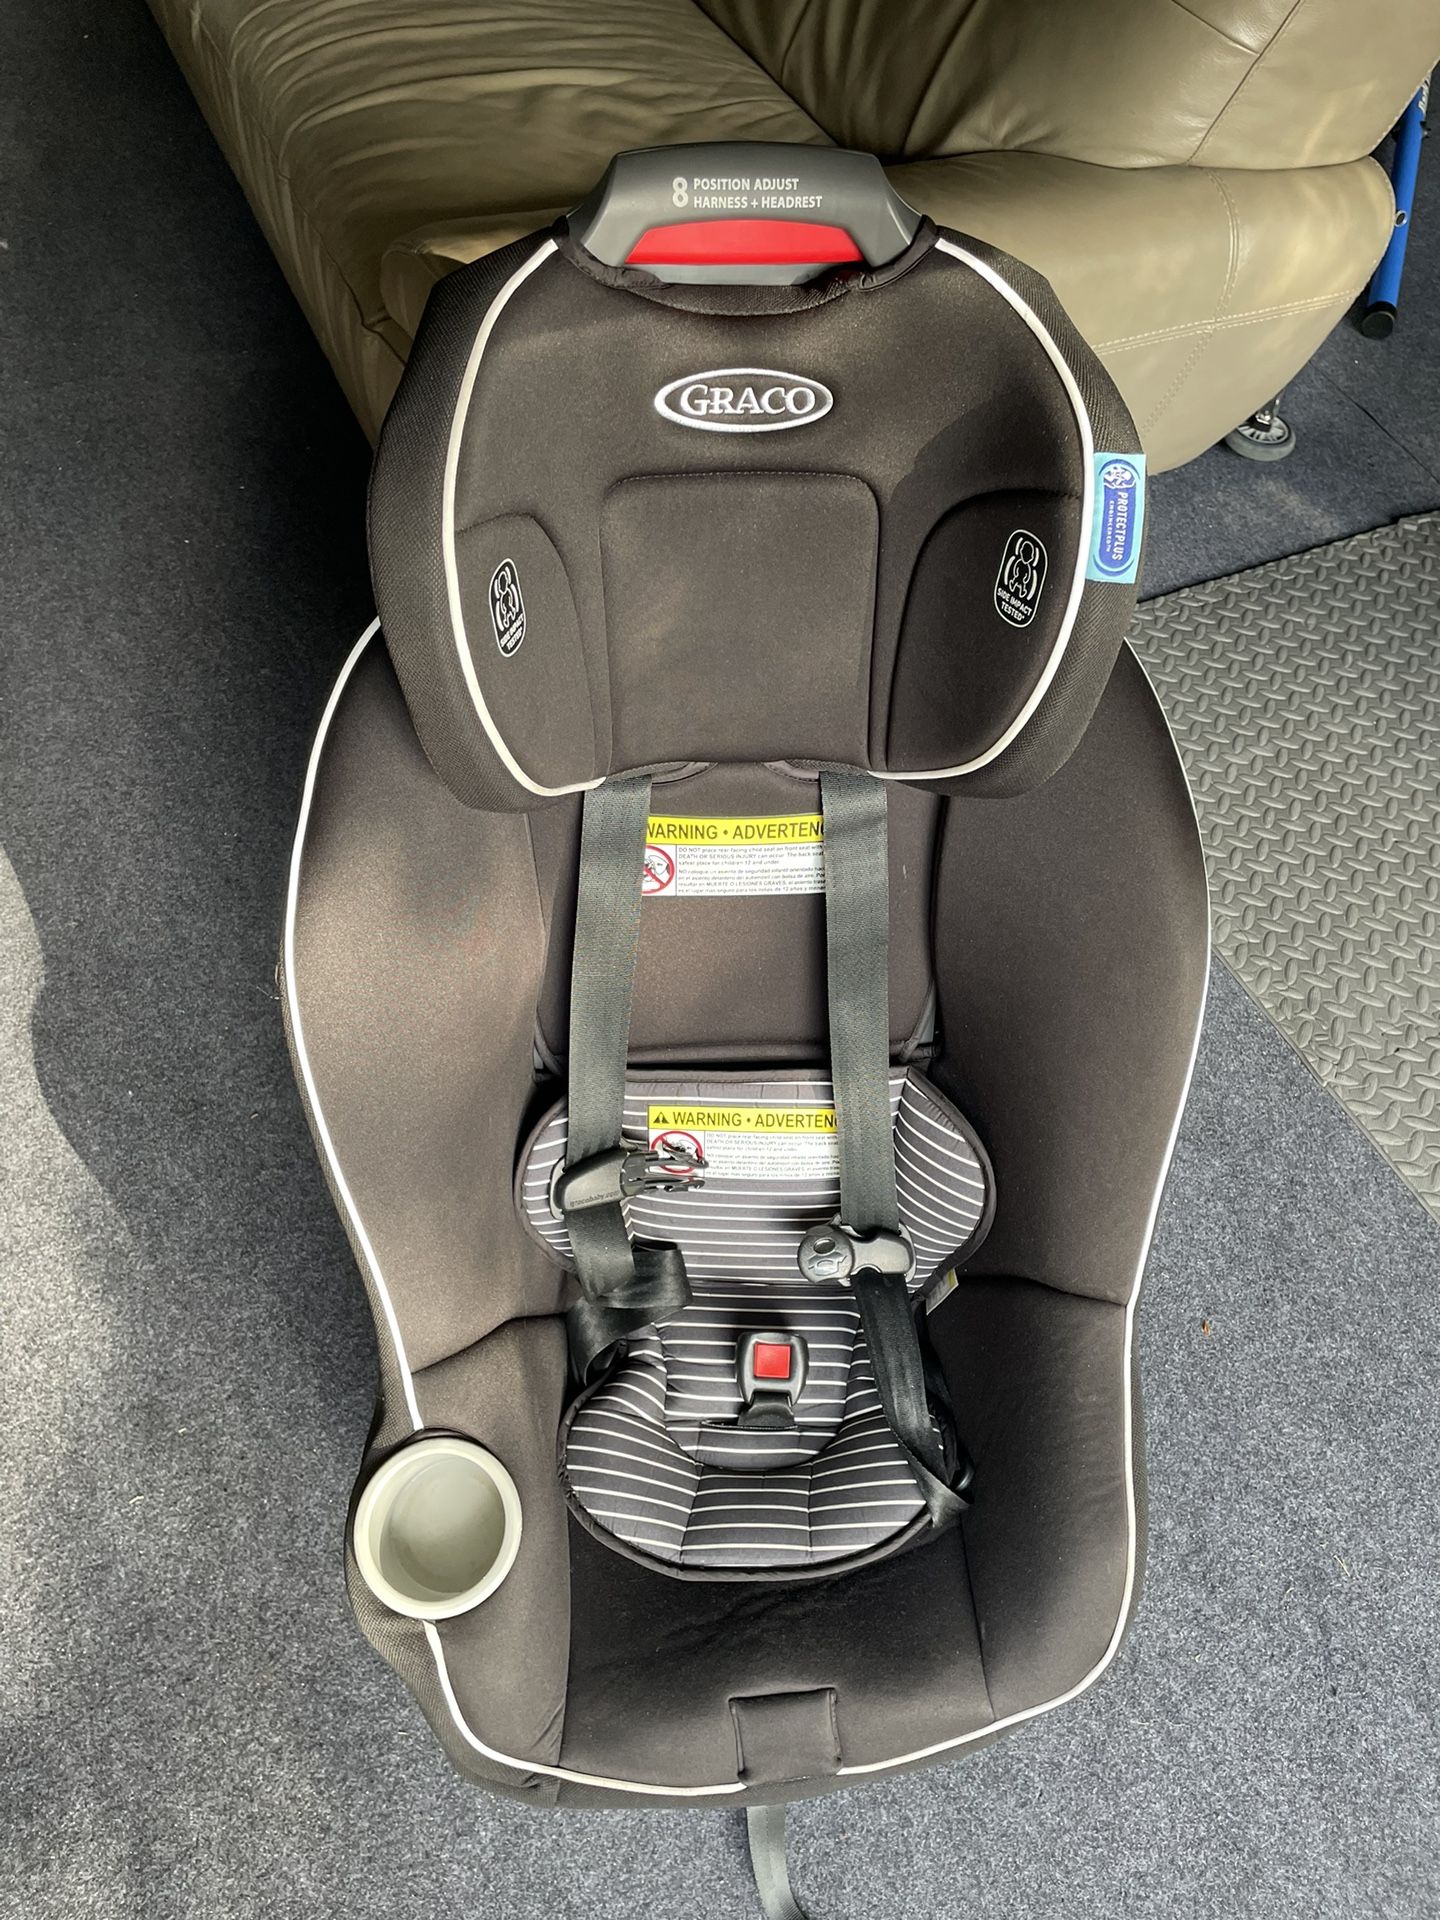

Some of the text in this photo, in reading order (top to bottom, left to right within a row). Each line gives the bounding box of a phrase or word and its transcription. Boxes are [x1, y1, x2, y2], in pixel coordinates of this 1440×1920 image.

[672, 177, 689, 208] 8
[693, 178, 800, 191] POSITION ADJUST
[693, 196, 748, 209] HARNESS
[761, 195, 823, 209] HEADREST
[680, 384, 816, 416] GRACO
[1112, 491, 1129, 561] PROTECTPLUS
[997, 587, 1033, 616] SIDE IMPACT
[672, 1111, 837, 1128] WARNING ADVERTEN
